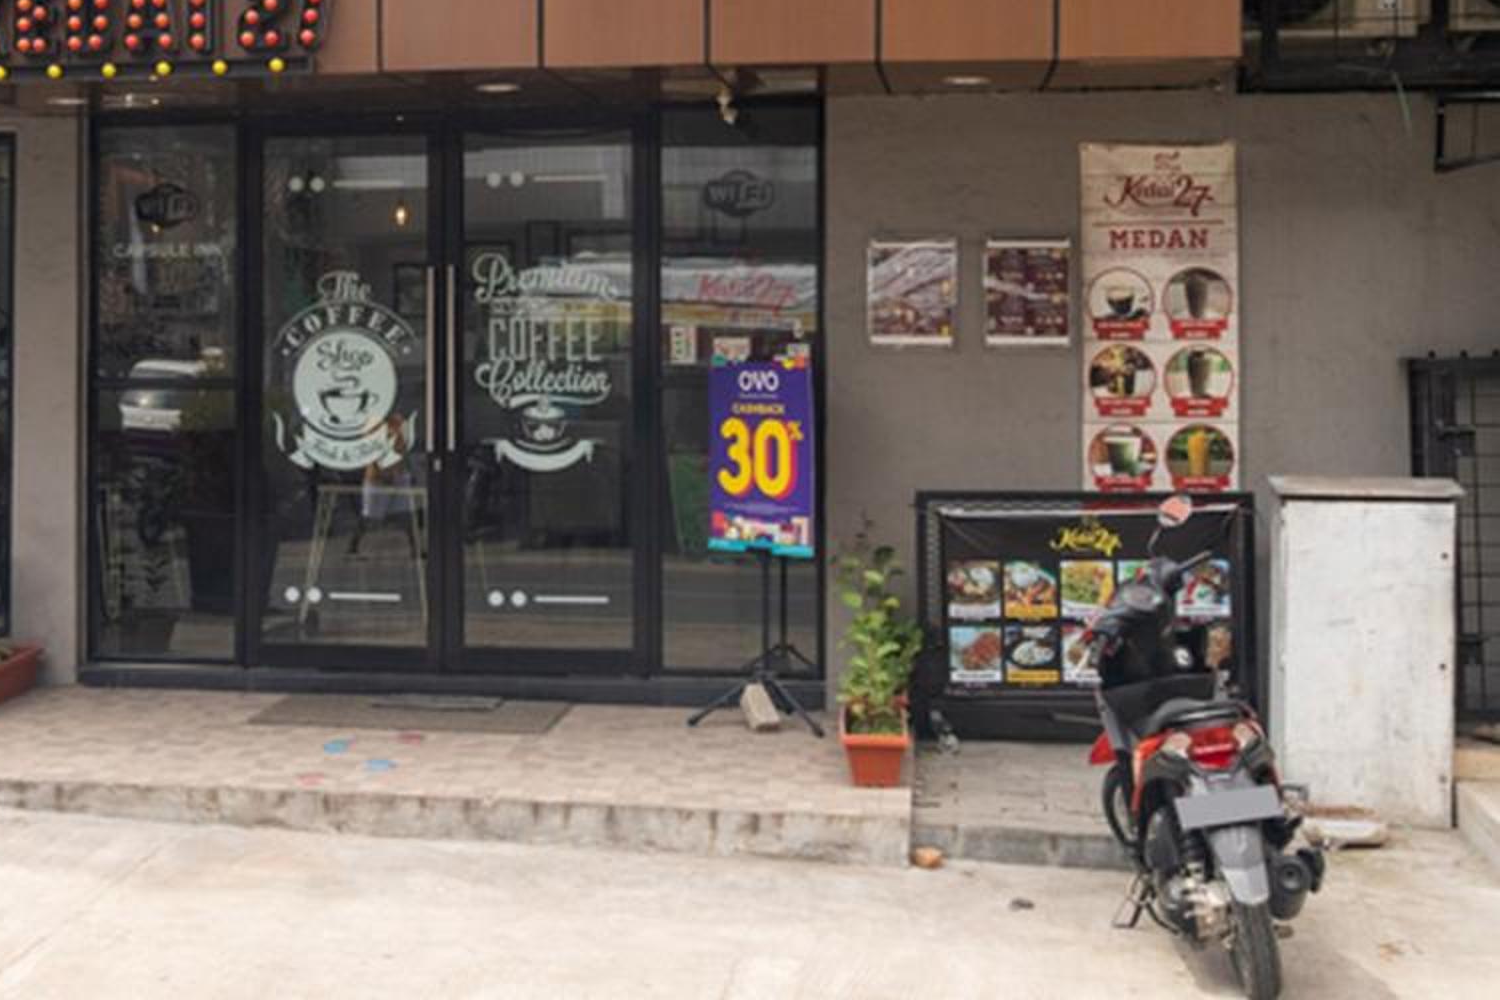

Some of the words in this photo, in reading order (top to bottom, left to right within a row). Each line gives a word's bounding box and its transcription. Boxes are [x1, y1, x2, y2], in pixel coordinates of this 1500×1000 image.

[1103, 174, 1174, 208] Kedai
[1172, 173, 1215, 217] 27
[1108, 228, 1209, 250] MEDAN
[316, 269, 372, 301] The
[472, 253, 619, 304] Premium
[286, 305, 405, 346] COFFEE
[489, 317, 603, 361] COFFEE
[316, 338, 375, 371] Shop
[475, 358, 612, 408] Collection
[738, 370, 779, 391] OVO
[731, 402, 785, 415] CASHBACK
